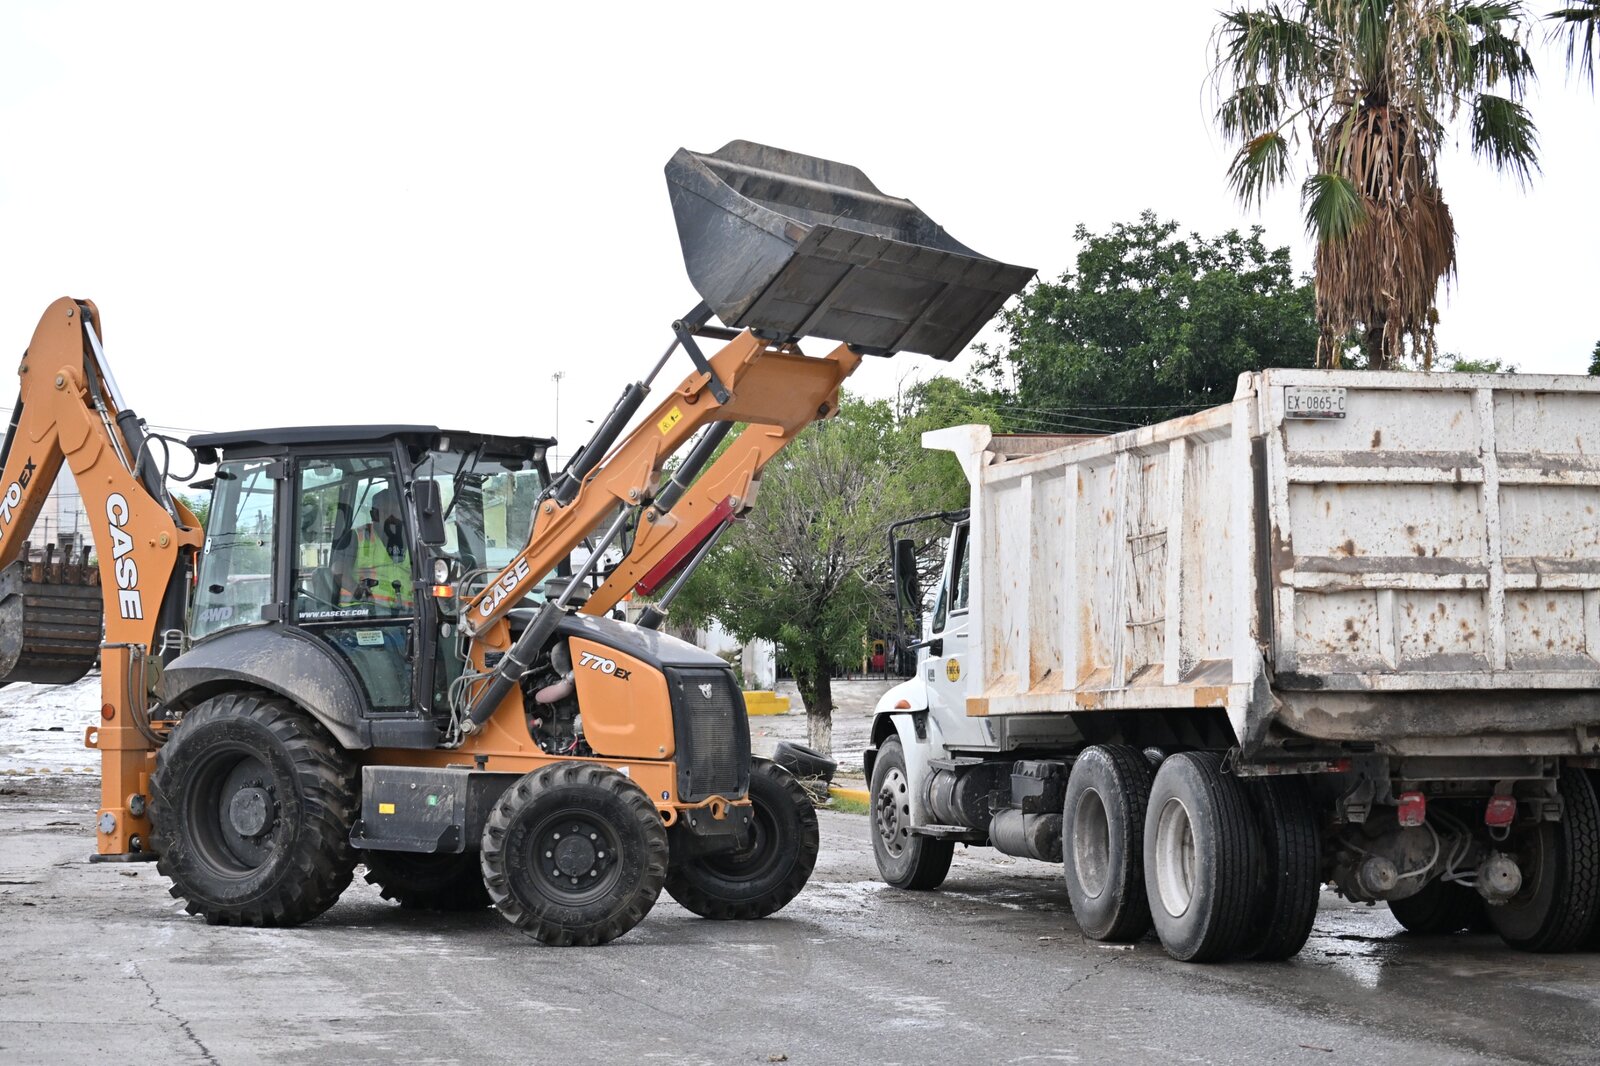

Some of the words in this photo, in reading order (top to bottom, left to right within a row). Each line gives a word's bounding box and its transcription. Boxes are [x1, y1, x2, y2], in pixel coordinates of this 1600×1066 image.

[1287, 395, 1345, 410] EX-0865-C
[106, 492, 144, 620] CASE
[479, 557, 530, 617] CASE
[199, 606, 233, 622] 4WD
